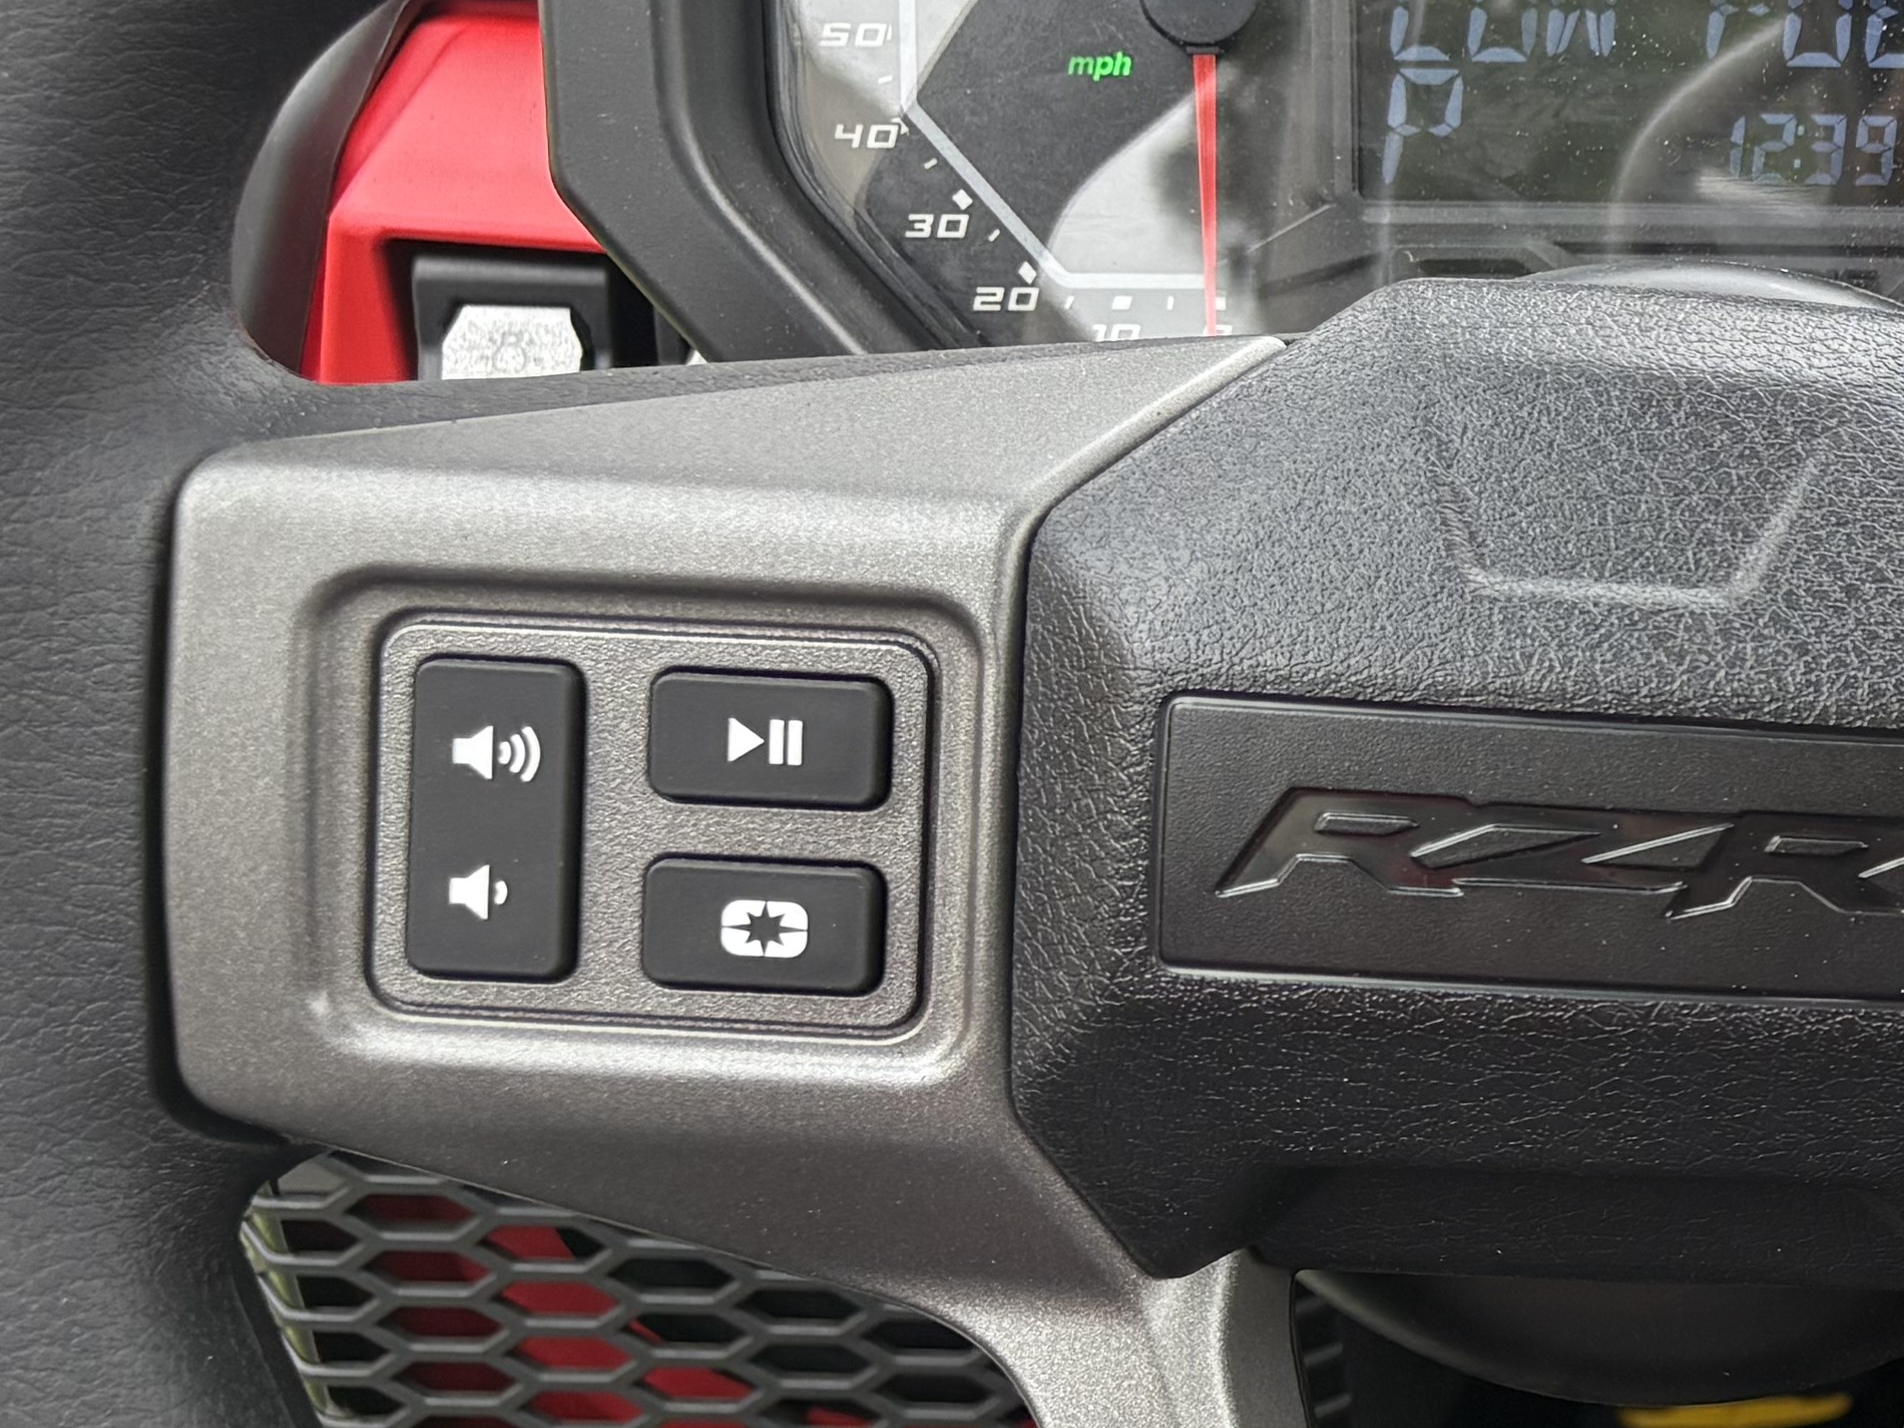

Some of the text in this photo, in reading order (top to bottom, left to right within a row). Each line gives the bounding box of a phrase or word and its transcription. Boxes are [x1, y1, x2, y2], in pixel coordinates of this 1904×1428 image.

[819, 23, 886, 48] 50
[1067, 52, 1132, 81] mph
[834, 124, 897, 150] 40
[1382, 67, 1463, 184] P
[1729, 113, 1898, 186] 12:39
[904, 214, 970, 240] 30
[971, 287, 1041, 313] 20
